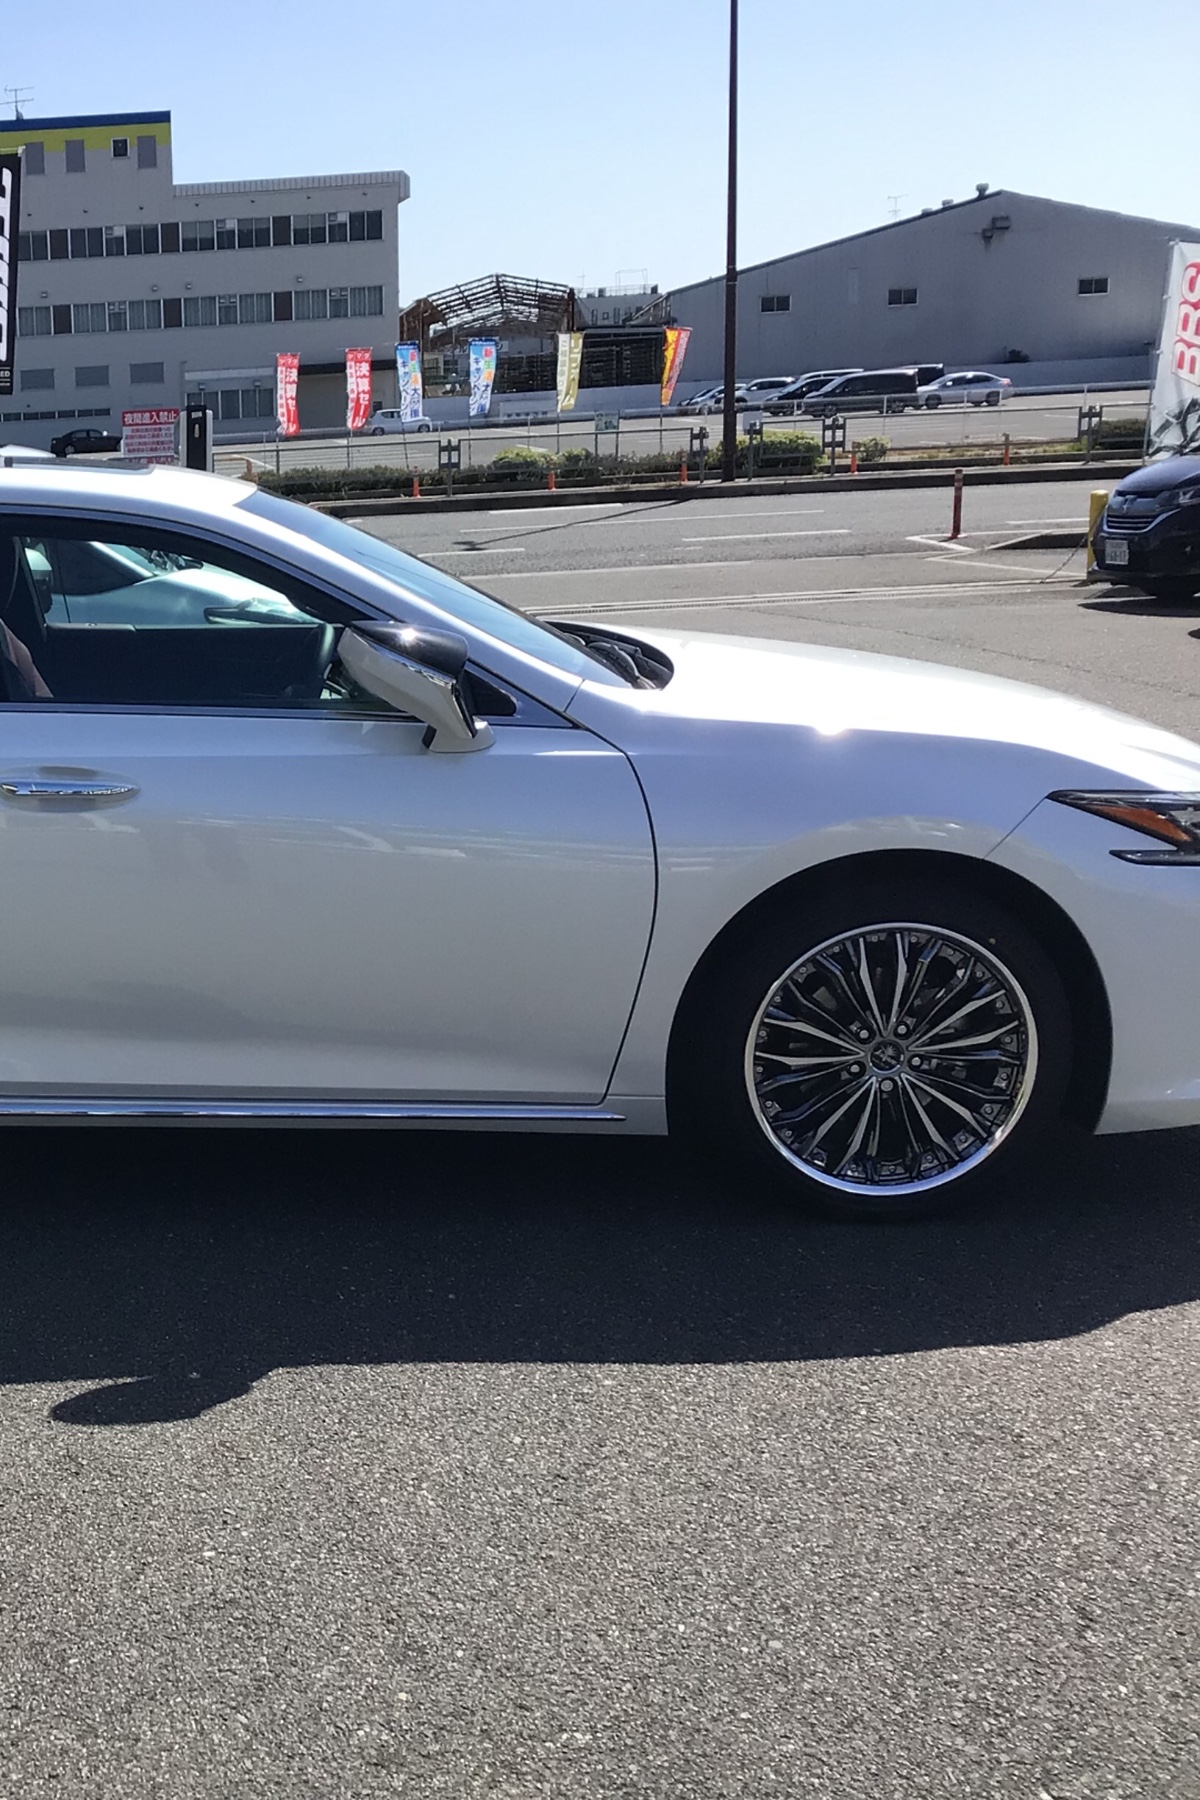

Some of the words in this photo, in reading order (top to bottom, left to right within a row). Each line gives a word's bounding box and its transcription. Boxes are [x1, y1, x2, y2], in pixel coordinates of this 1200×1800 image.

[124, 411, 178, 424] 夜間進入禁止
